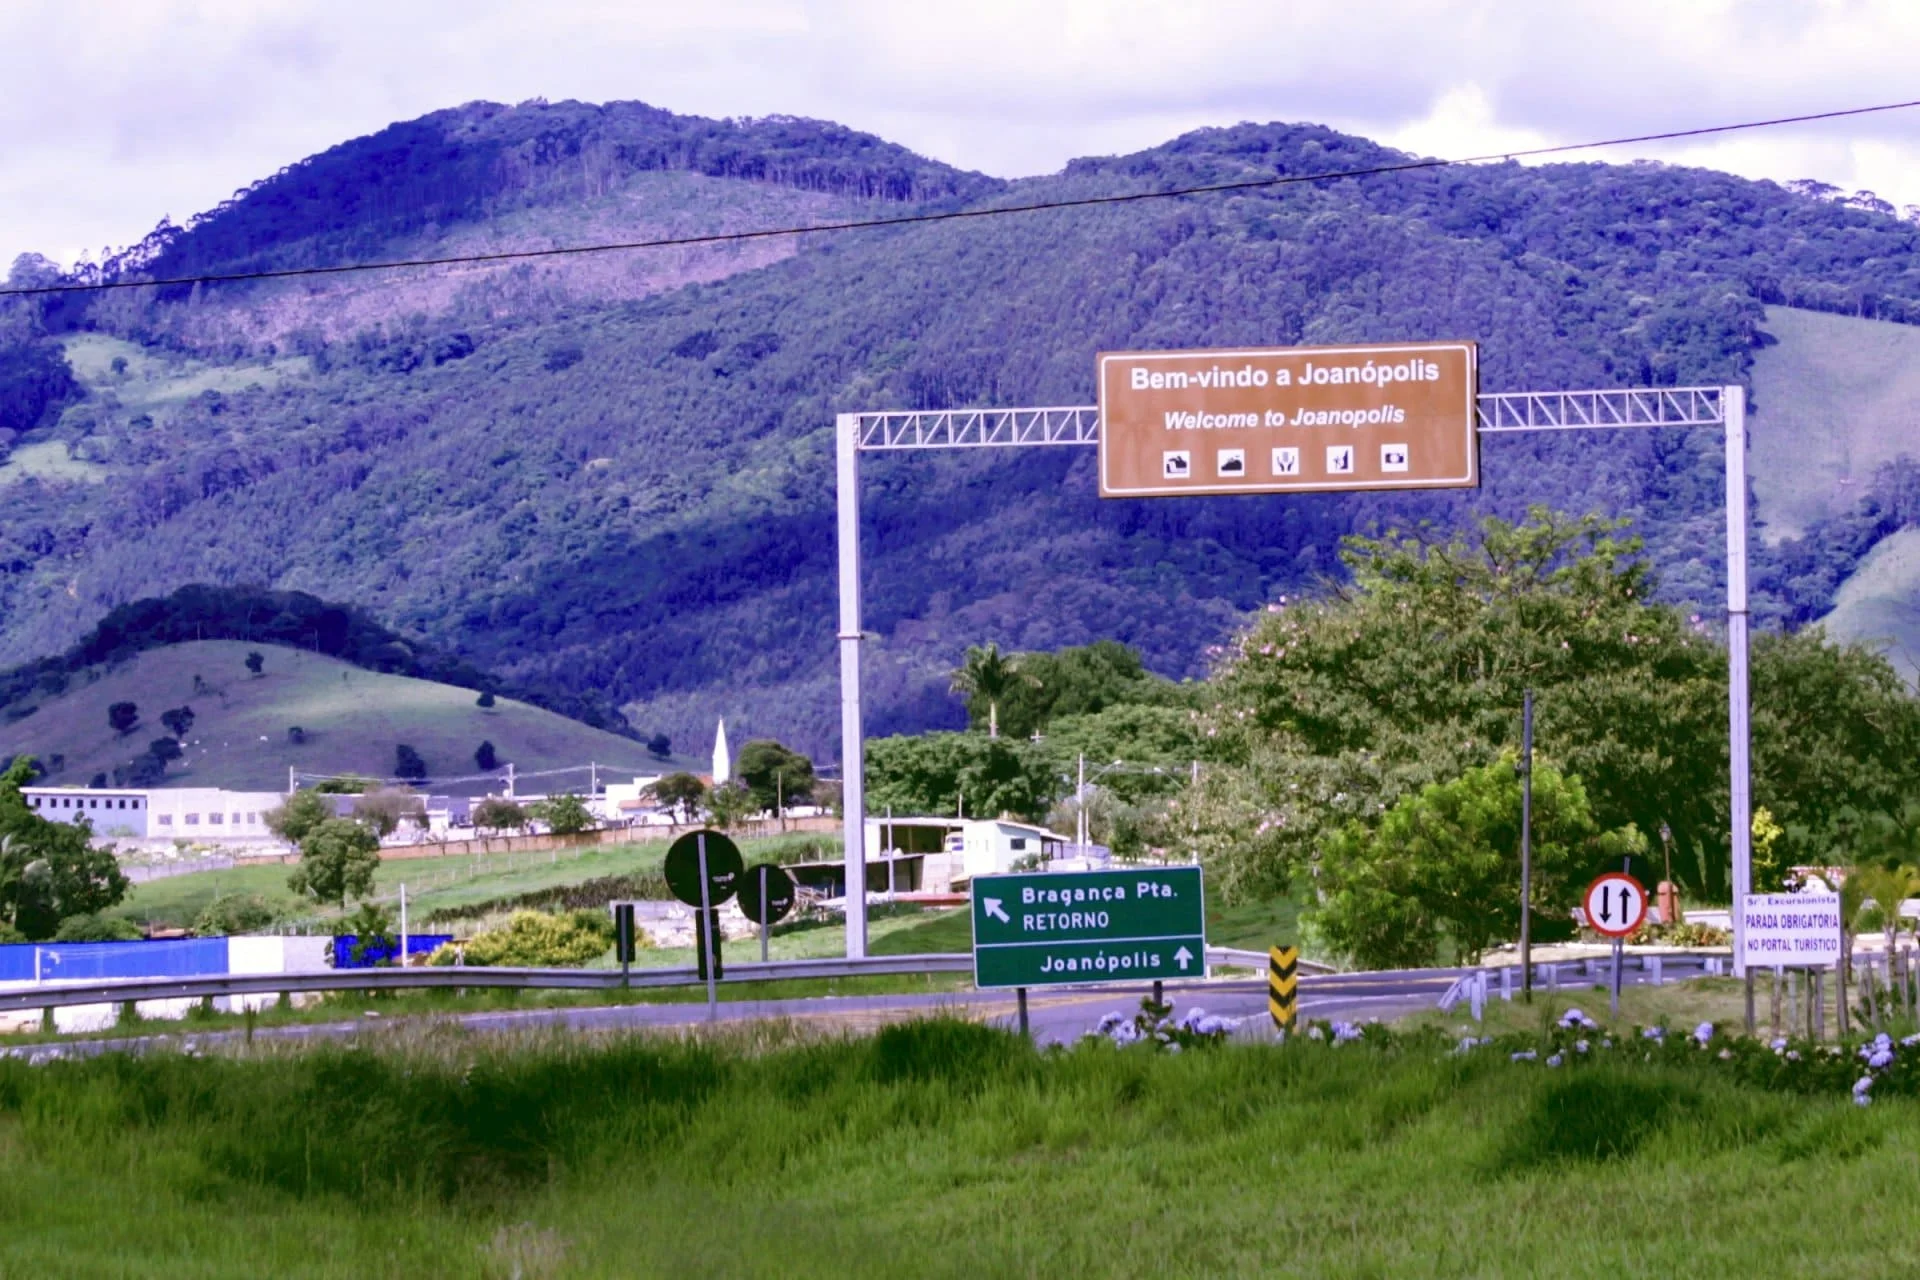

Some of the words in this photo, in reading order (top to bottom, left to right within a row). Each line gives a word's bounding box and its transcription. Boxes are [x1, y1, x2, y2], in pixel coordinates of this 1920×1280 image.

[1131, 365, 1268, 390] Bem-vindo
[1275, 368, 1290, 386] a
[1298, 359, 1440, 386] Joanópolis
[1164, 412, 1258, 430] Welcome
[1264, 409, 1285, 428] to
[1290, 406, 1405, 427] Joanopolis
[1022, 886, 1125, 906] Bragança
[1136, 881, 1178, 899] Pta.
[1023, 911, 1109, 931] RETORNO
[1745, 914, 1778, 929] PARADA
[1780, 911, 1838, 929] OBRIGATÓRIA
[1748, 939, 1759, 951] NO
[1761, 938, 1792, 951] PORTAL
[1794, 936, 1837, 951] TURÍSTICO
[1040, 950, 1161, 972] Joanópolis
